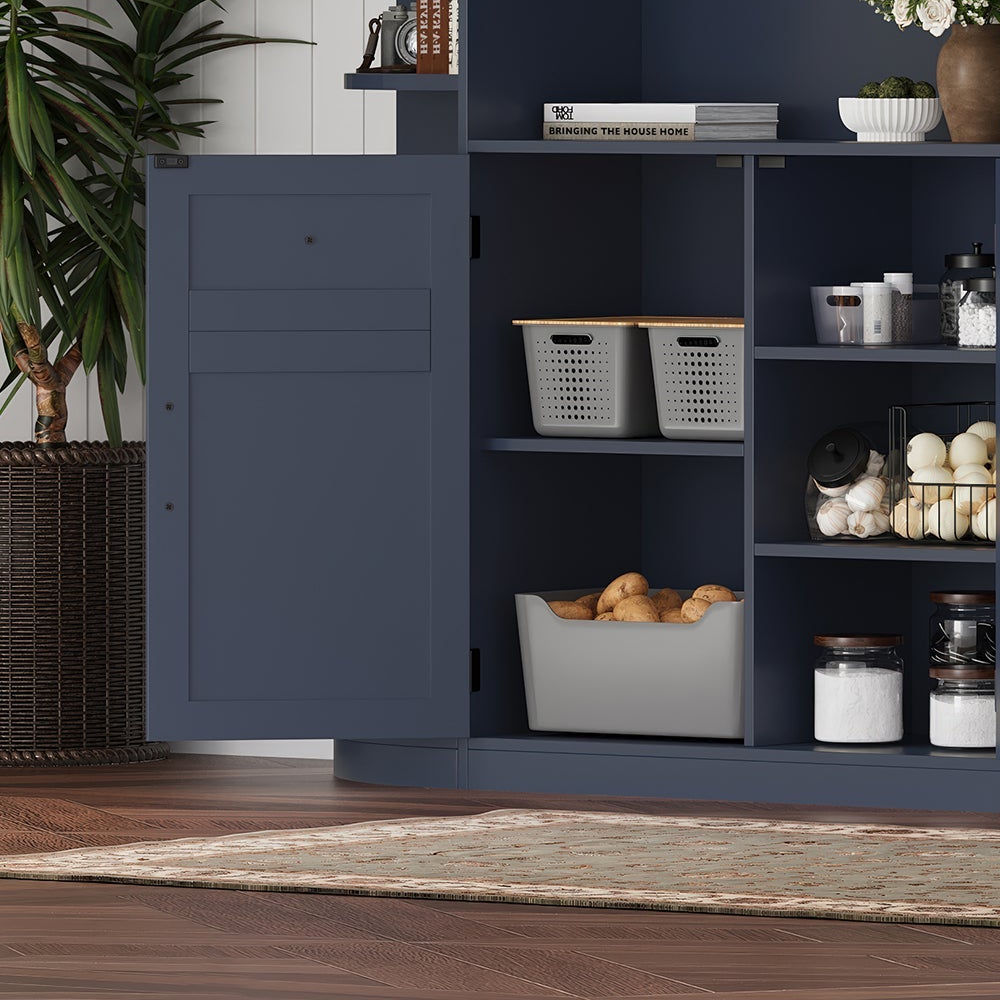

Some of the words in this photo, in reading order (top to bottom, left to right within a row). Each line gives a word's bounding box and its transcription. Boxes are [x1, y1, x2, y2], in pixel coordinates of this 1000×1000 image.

[549, 127, 598, 136] BRINGING
[600, 127, 621, 136] THE
[623, 127, 657, 136] HOUSE
[660, 127, 689, 136] HOME
